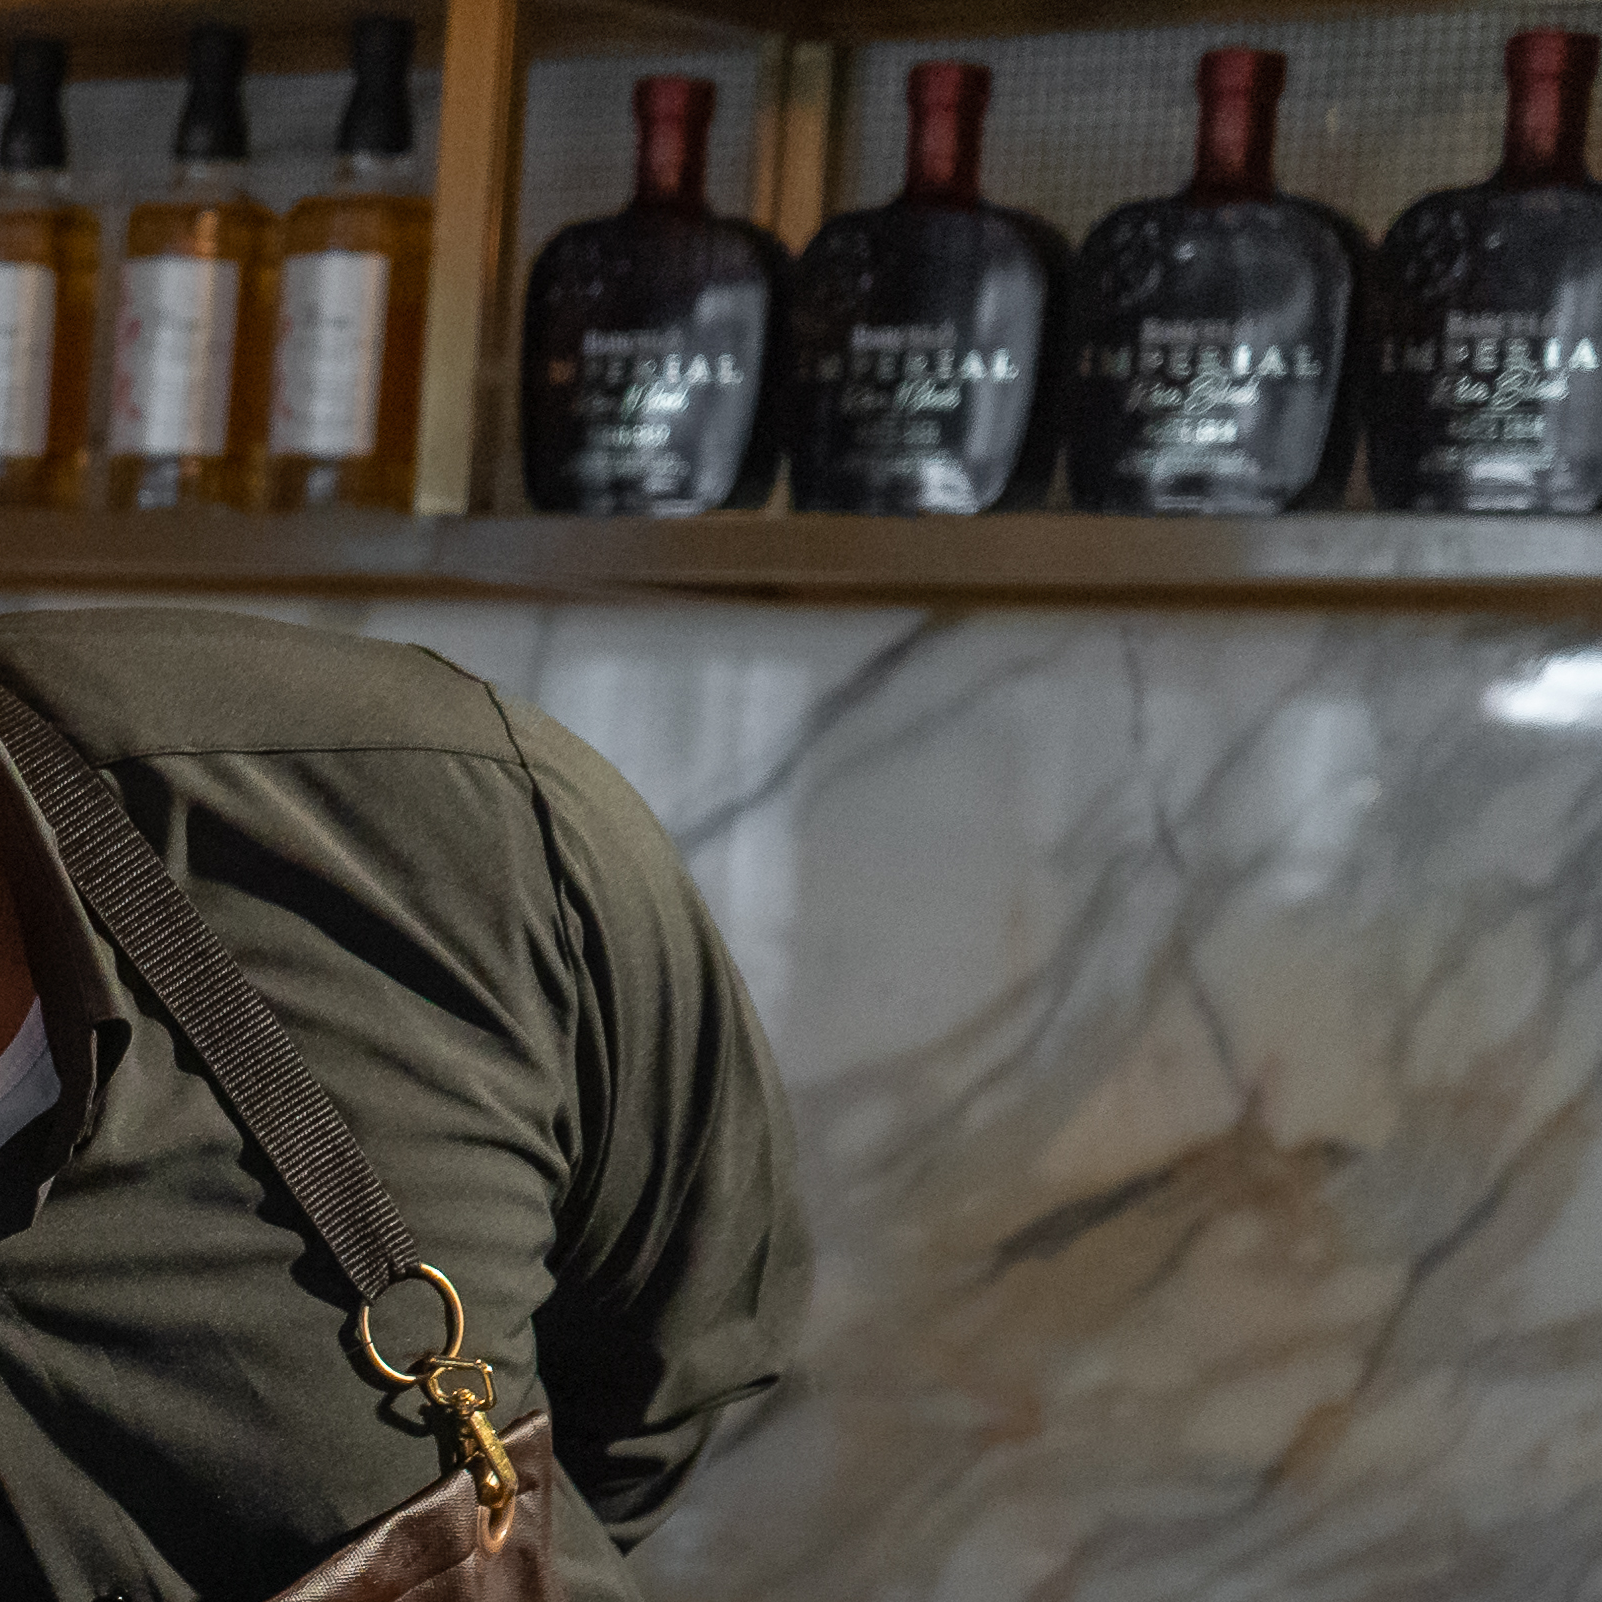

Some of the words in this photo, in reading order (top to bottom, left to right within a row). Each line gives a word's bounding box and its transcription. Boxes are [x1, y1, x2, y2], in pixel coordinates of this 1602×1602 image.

[548, 353, 744, 387] MPERIAL
[1079, 344, 1323, 382] IMPERIAL
[1381, 337, 1601, 374] IMPERIA
